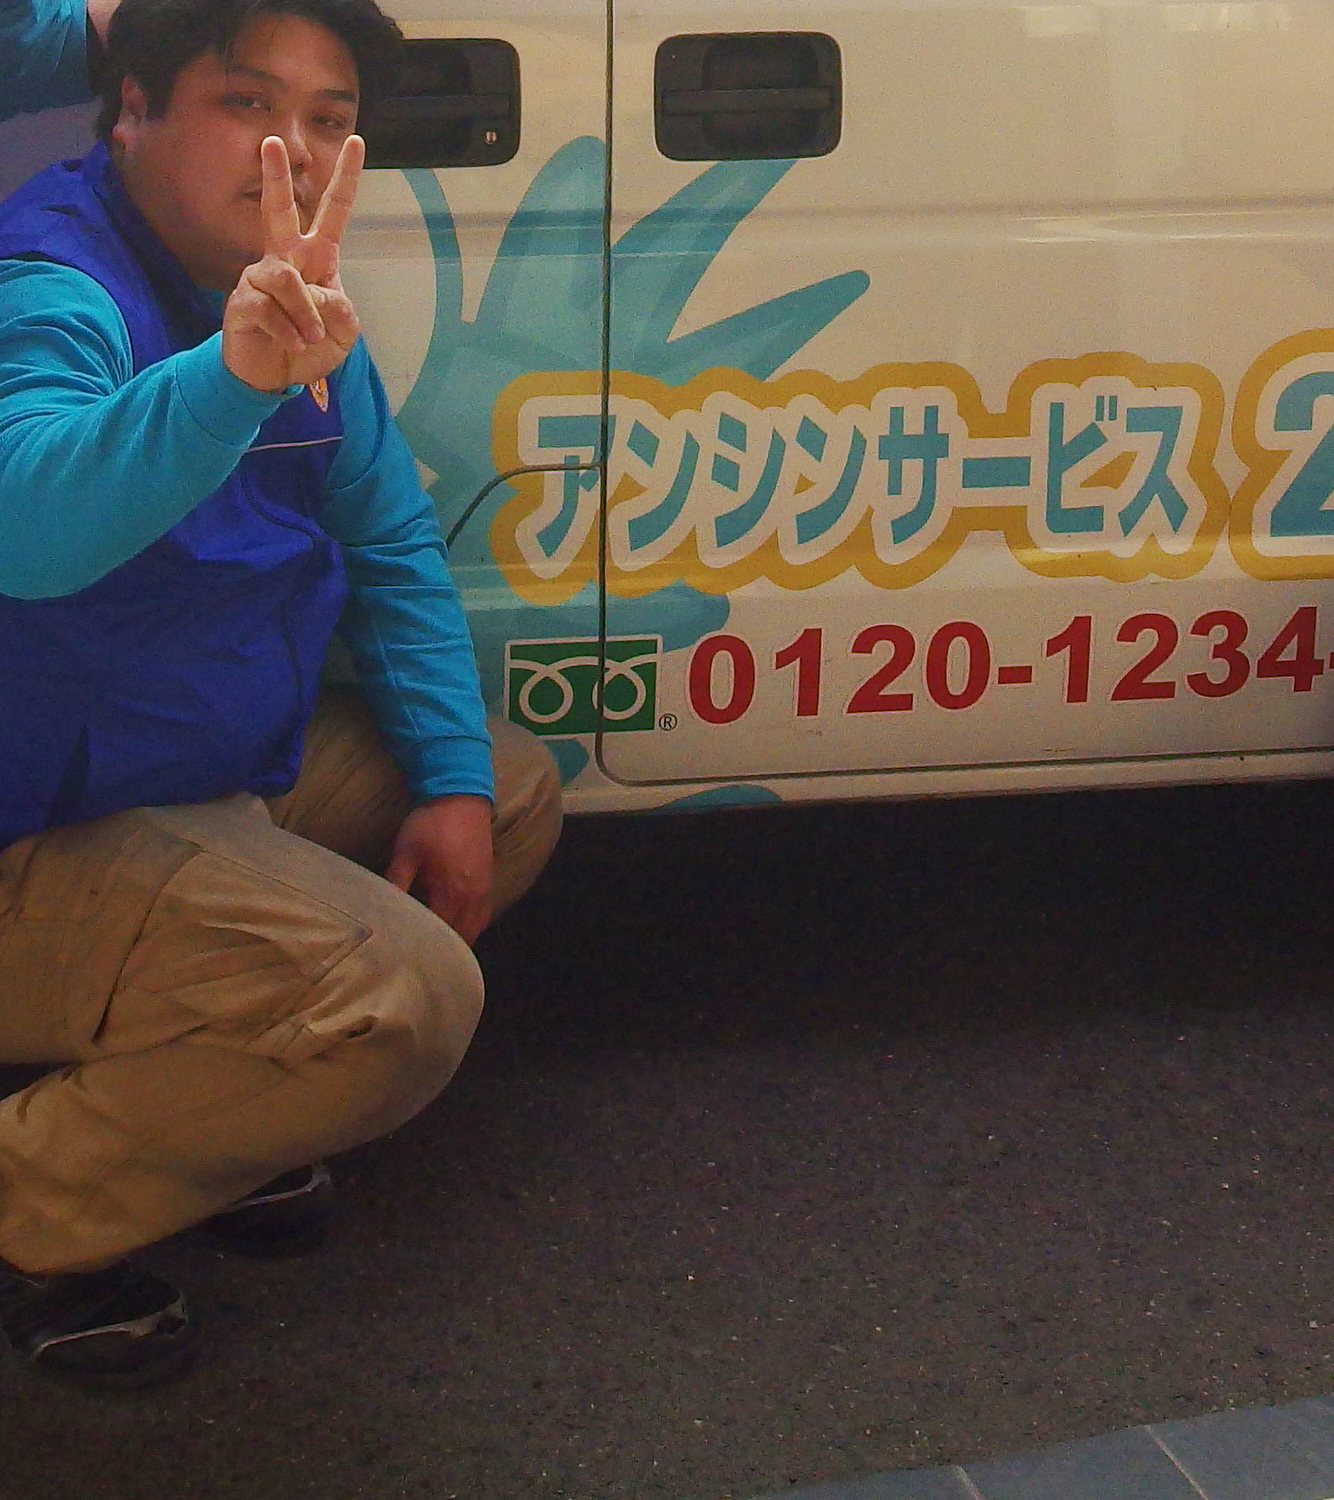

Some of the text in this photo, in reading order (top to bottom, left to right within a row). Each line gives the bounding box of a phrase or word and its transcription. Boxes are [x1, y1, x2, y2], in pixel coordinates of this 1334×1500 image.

[531, 390, 1195, 560] アンシンサービス
